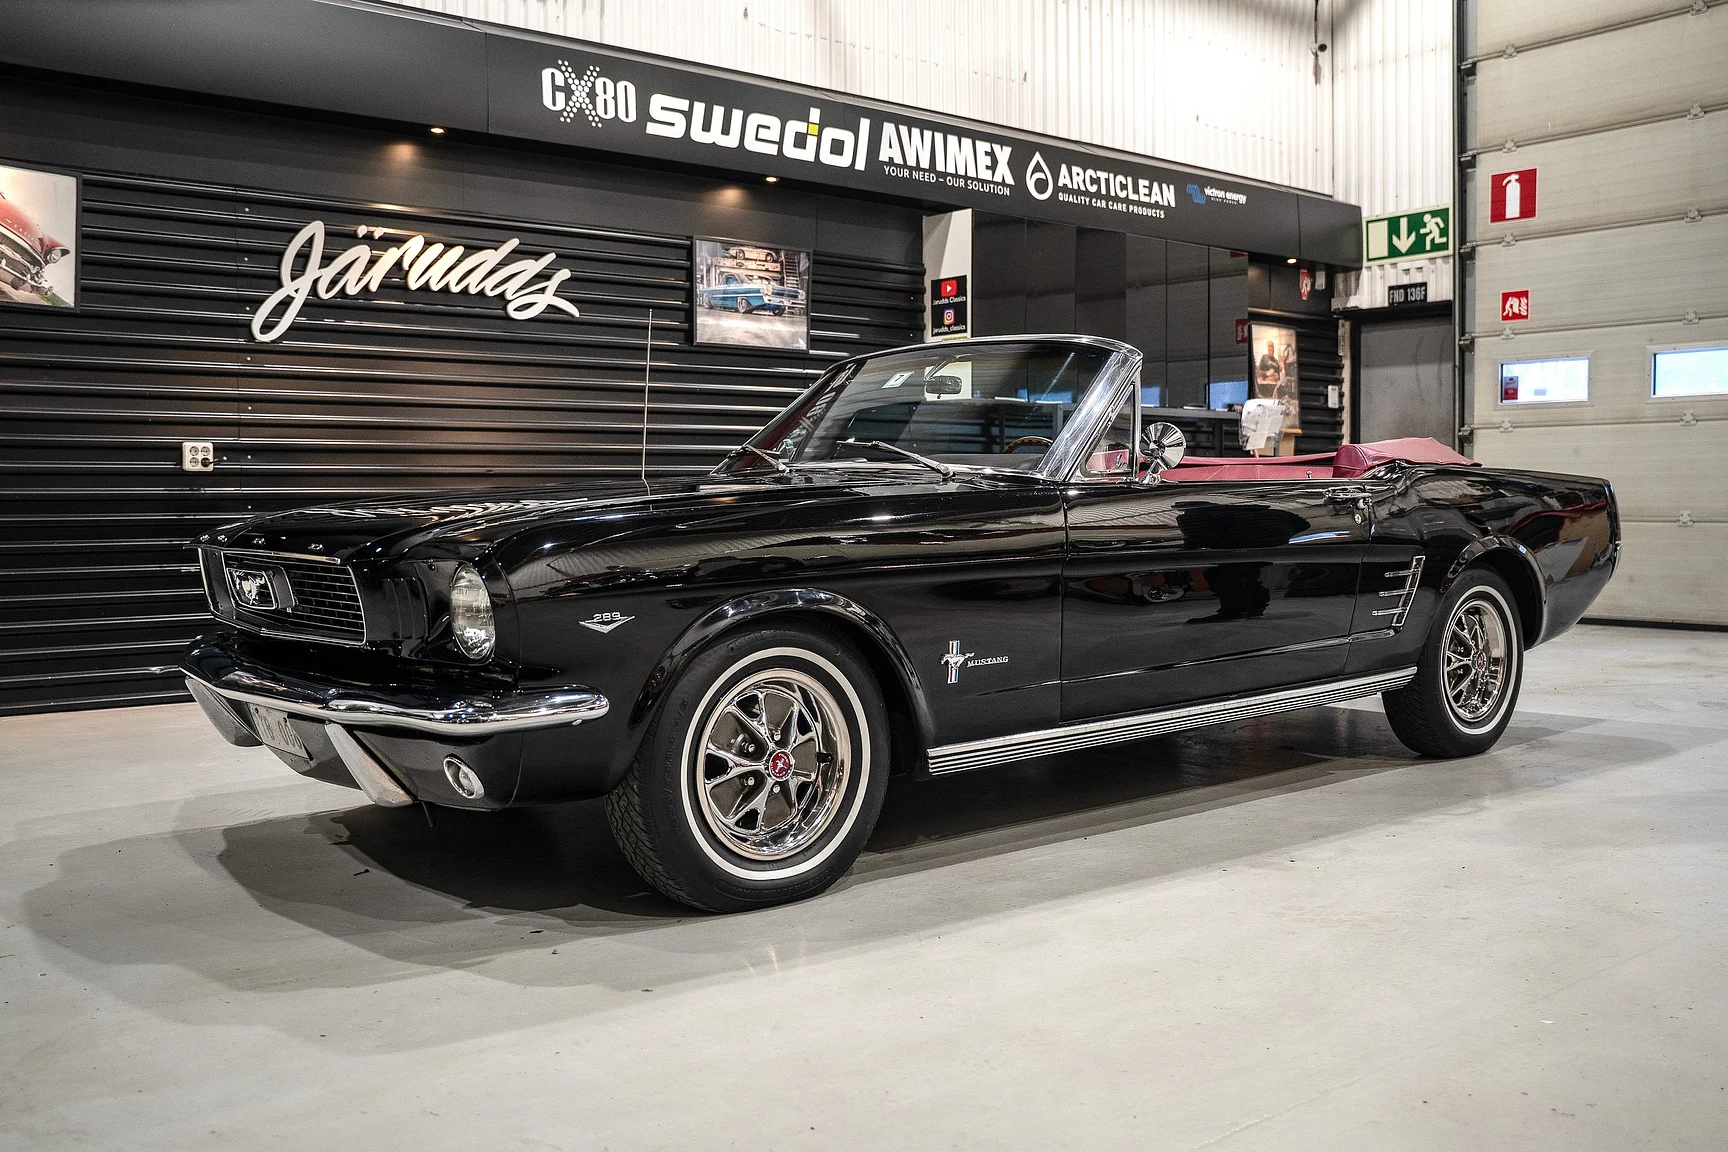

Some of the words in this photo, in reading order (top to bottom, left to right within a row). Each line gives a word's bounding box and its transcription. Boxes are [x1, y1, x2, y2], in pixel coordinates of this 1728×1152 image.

[541, 59, 637, 128] CX80
[645, 93, 871, 171] swedol
[879, 121, 1015, 185] AWIMEX
[883, 165, 910, 179] YOUR
[912, 170, 937, 183] NEED
[946, 176, 966, 188] OUR
[967, 180, 1010, 197] SOLUTION
[1058, 163, 1176, 208] ARCTICLEAN
[1058, 191, 1090, 206] QUALITY
[1091, 198, 1107, 209] CAR
[1108, 201, 1128, 213] CARE
[1128, 204, 1166, 219] PRODUCTS
[1389, 289, 1405, 304] FND
[1407, 286, 1426, 302] 136F
[592, 611, 621, 622] 289
[966, 656, 1009, 668] MUSTANG
